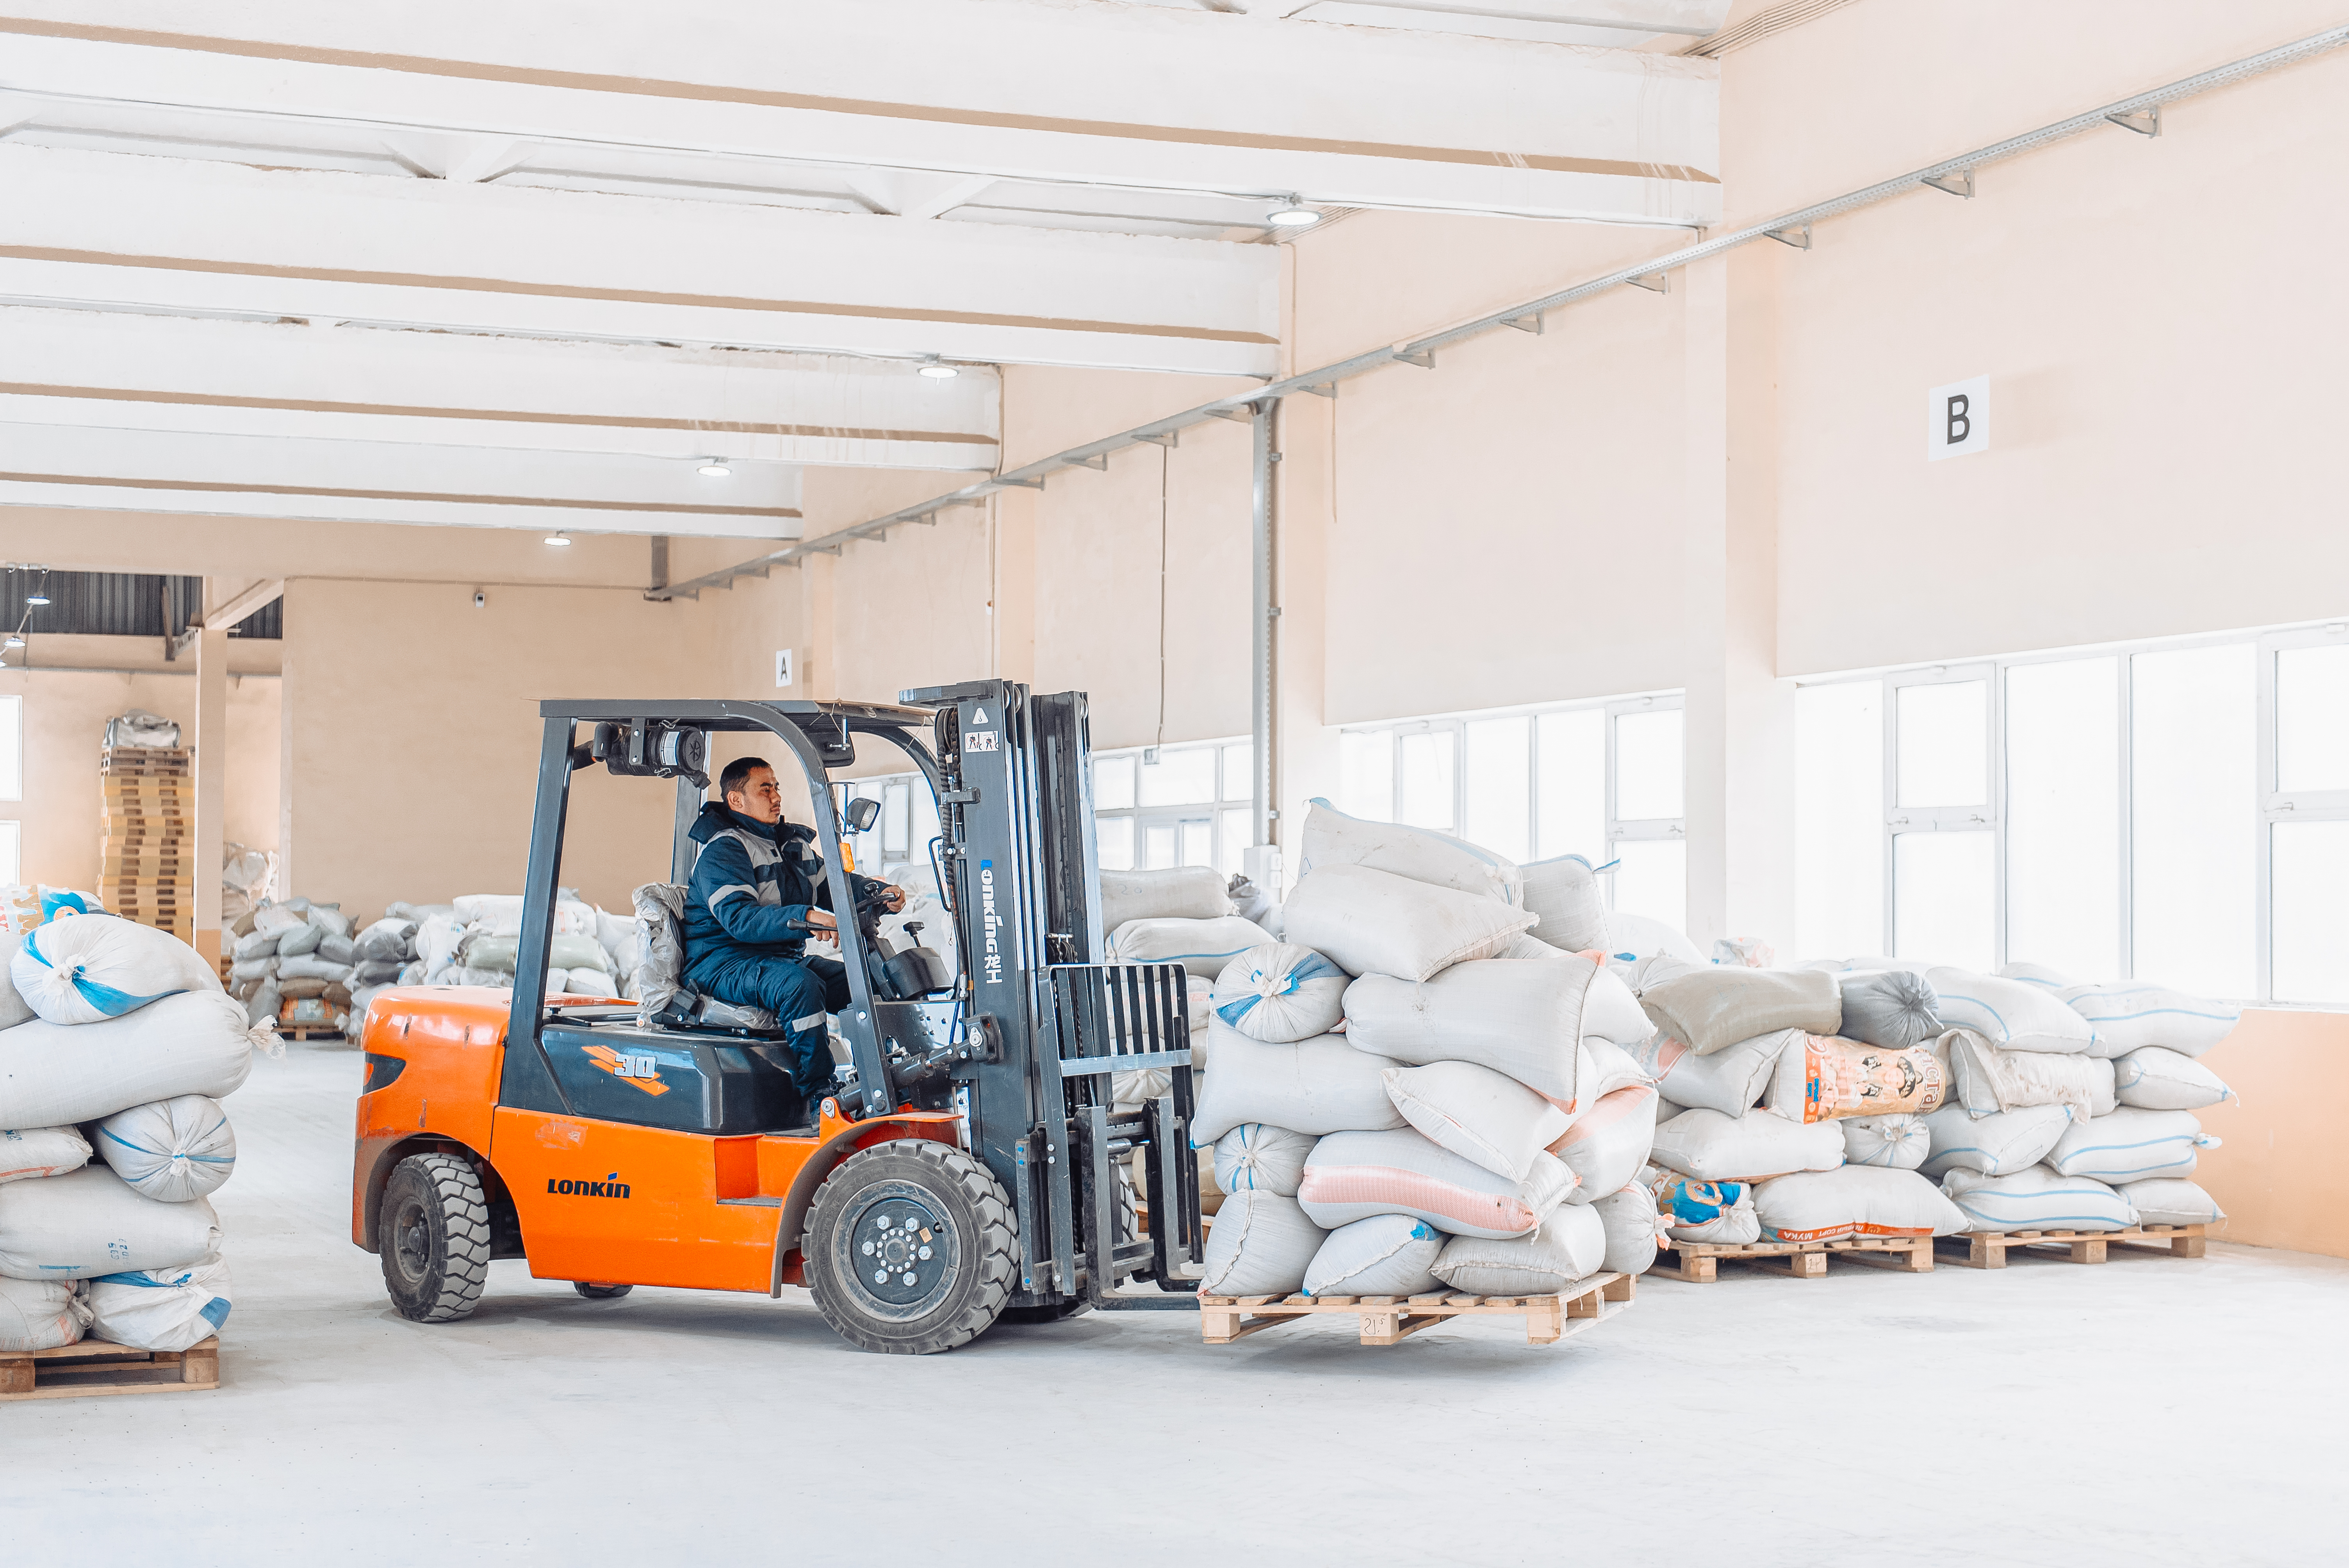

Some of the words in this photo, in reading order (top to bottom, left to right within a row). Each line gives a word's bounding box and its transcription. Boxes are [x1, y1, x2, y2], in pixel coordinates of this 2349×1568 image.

[1947, 394, 1970, 445] B
[781, 656, 788, 680] A
[614, 1053, 658, 1078] 30
